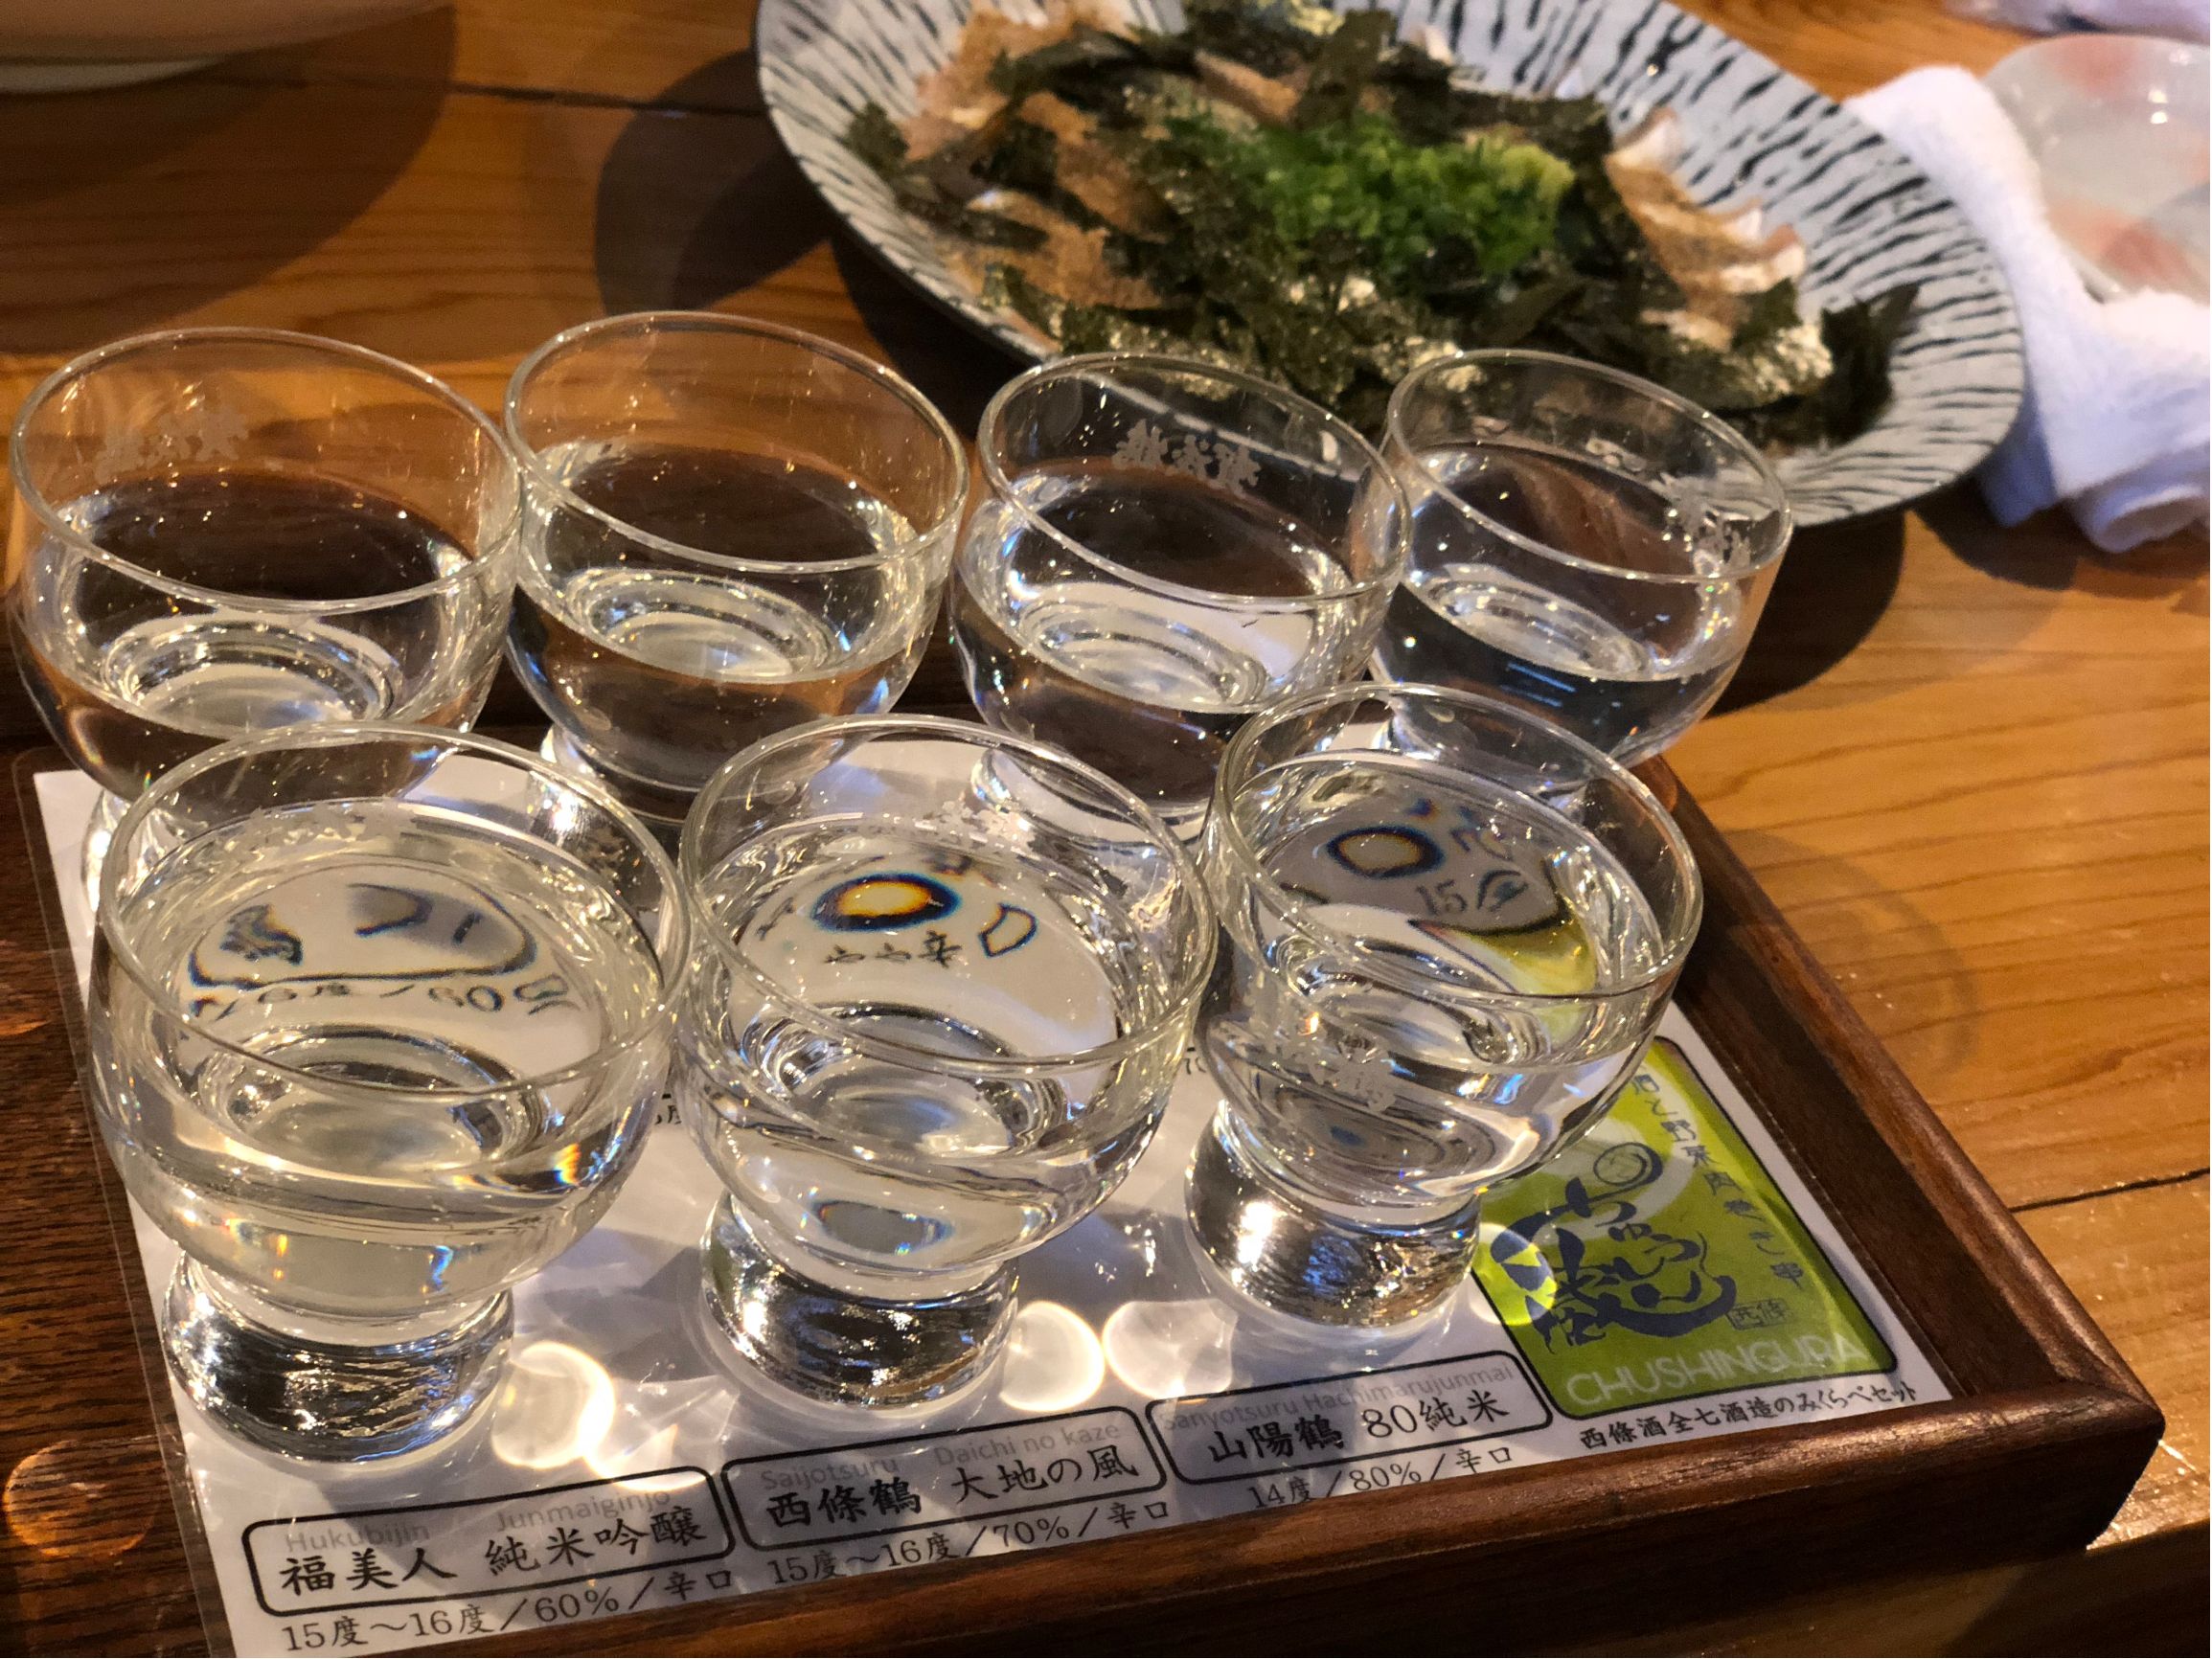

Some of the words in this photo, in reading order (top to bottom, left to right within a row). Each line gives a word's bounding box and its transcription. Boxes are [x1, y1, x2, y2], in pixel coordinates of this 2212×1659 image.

[1565, 1331, 1871, 1407] CHUSHINGURA
[1209, 1413, 1344, 1465] 山陽鶴
[1362, 1387, 1511, 1439] 80純米
[1580, 1380, 1917, 1450] 西條酒全七酒造のみくらべセット
[761, 1454, 898, 1491] Saijotsuru
[934, 1439, 1016, 1466] Daichi
[1024, 1437, 1055, 1454] no
[1062, 1423, 1121, 1446] kaze
[765, 1475, 923, 1529] 西條鶴
[950, 1443, 1138, 1505] 大地の風
[287, 1523, 430, 1554] Hukubijin
[496, 1489, 671, 1534] Junmaiginjo
[280, 1547, 459, 1598] 福美人
